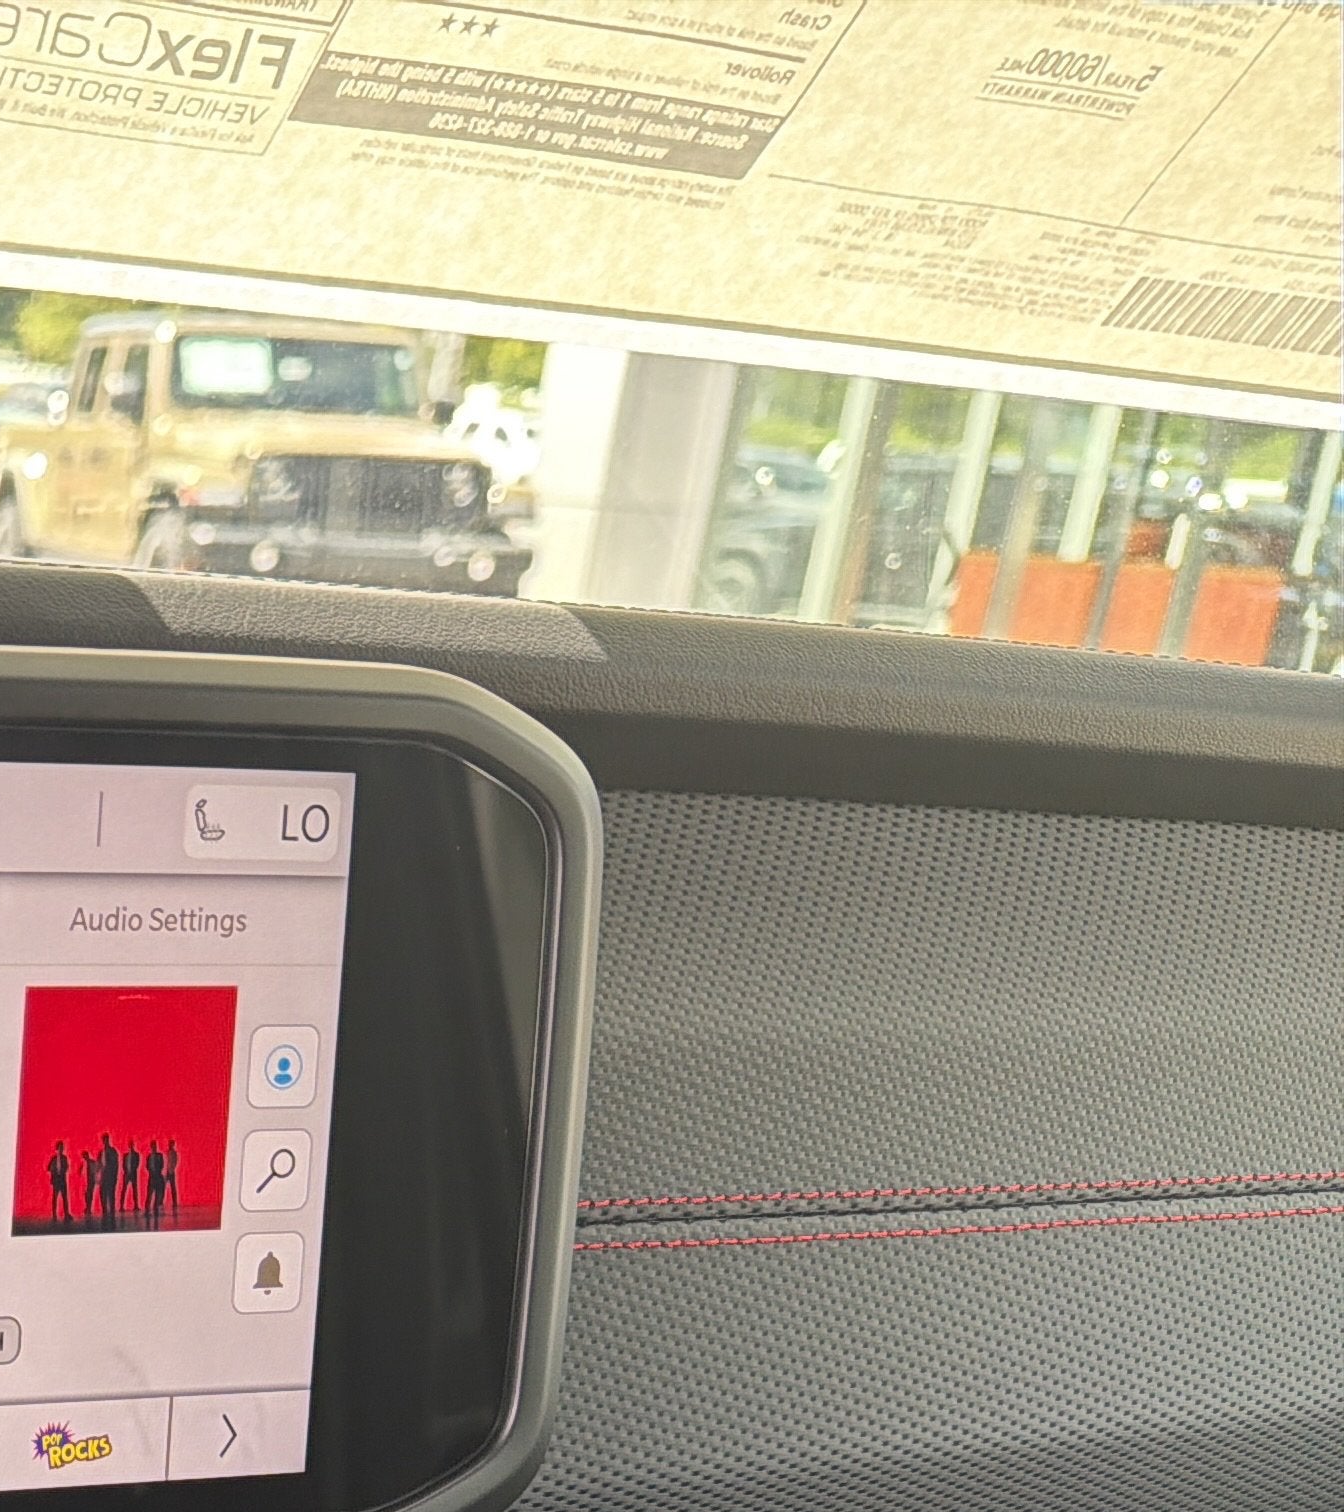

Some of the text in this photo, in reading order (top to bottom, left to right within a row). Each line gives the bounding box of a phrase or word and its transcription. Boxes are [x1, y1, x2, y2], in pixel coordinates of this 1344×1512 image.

[281, 804, 330, 843] LO
[70, 907, 248, 938] Audio Settings
[49, 1434, 112, 1470] ROCKS
